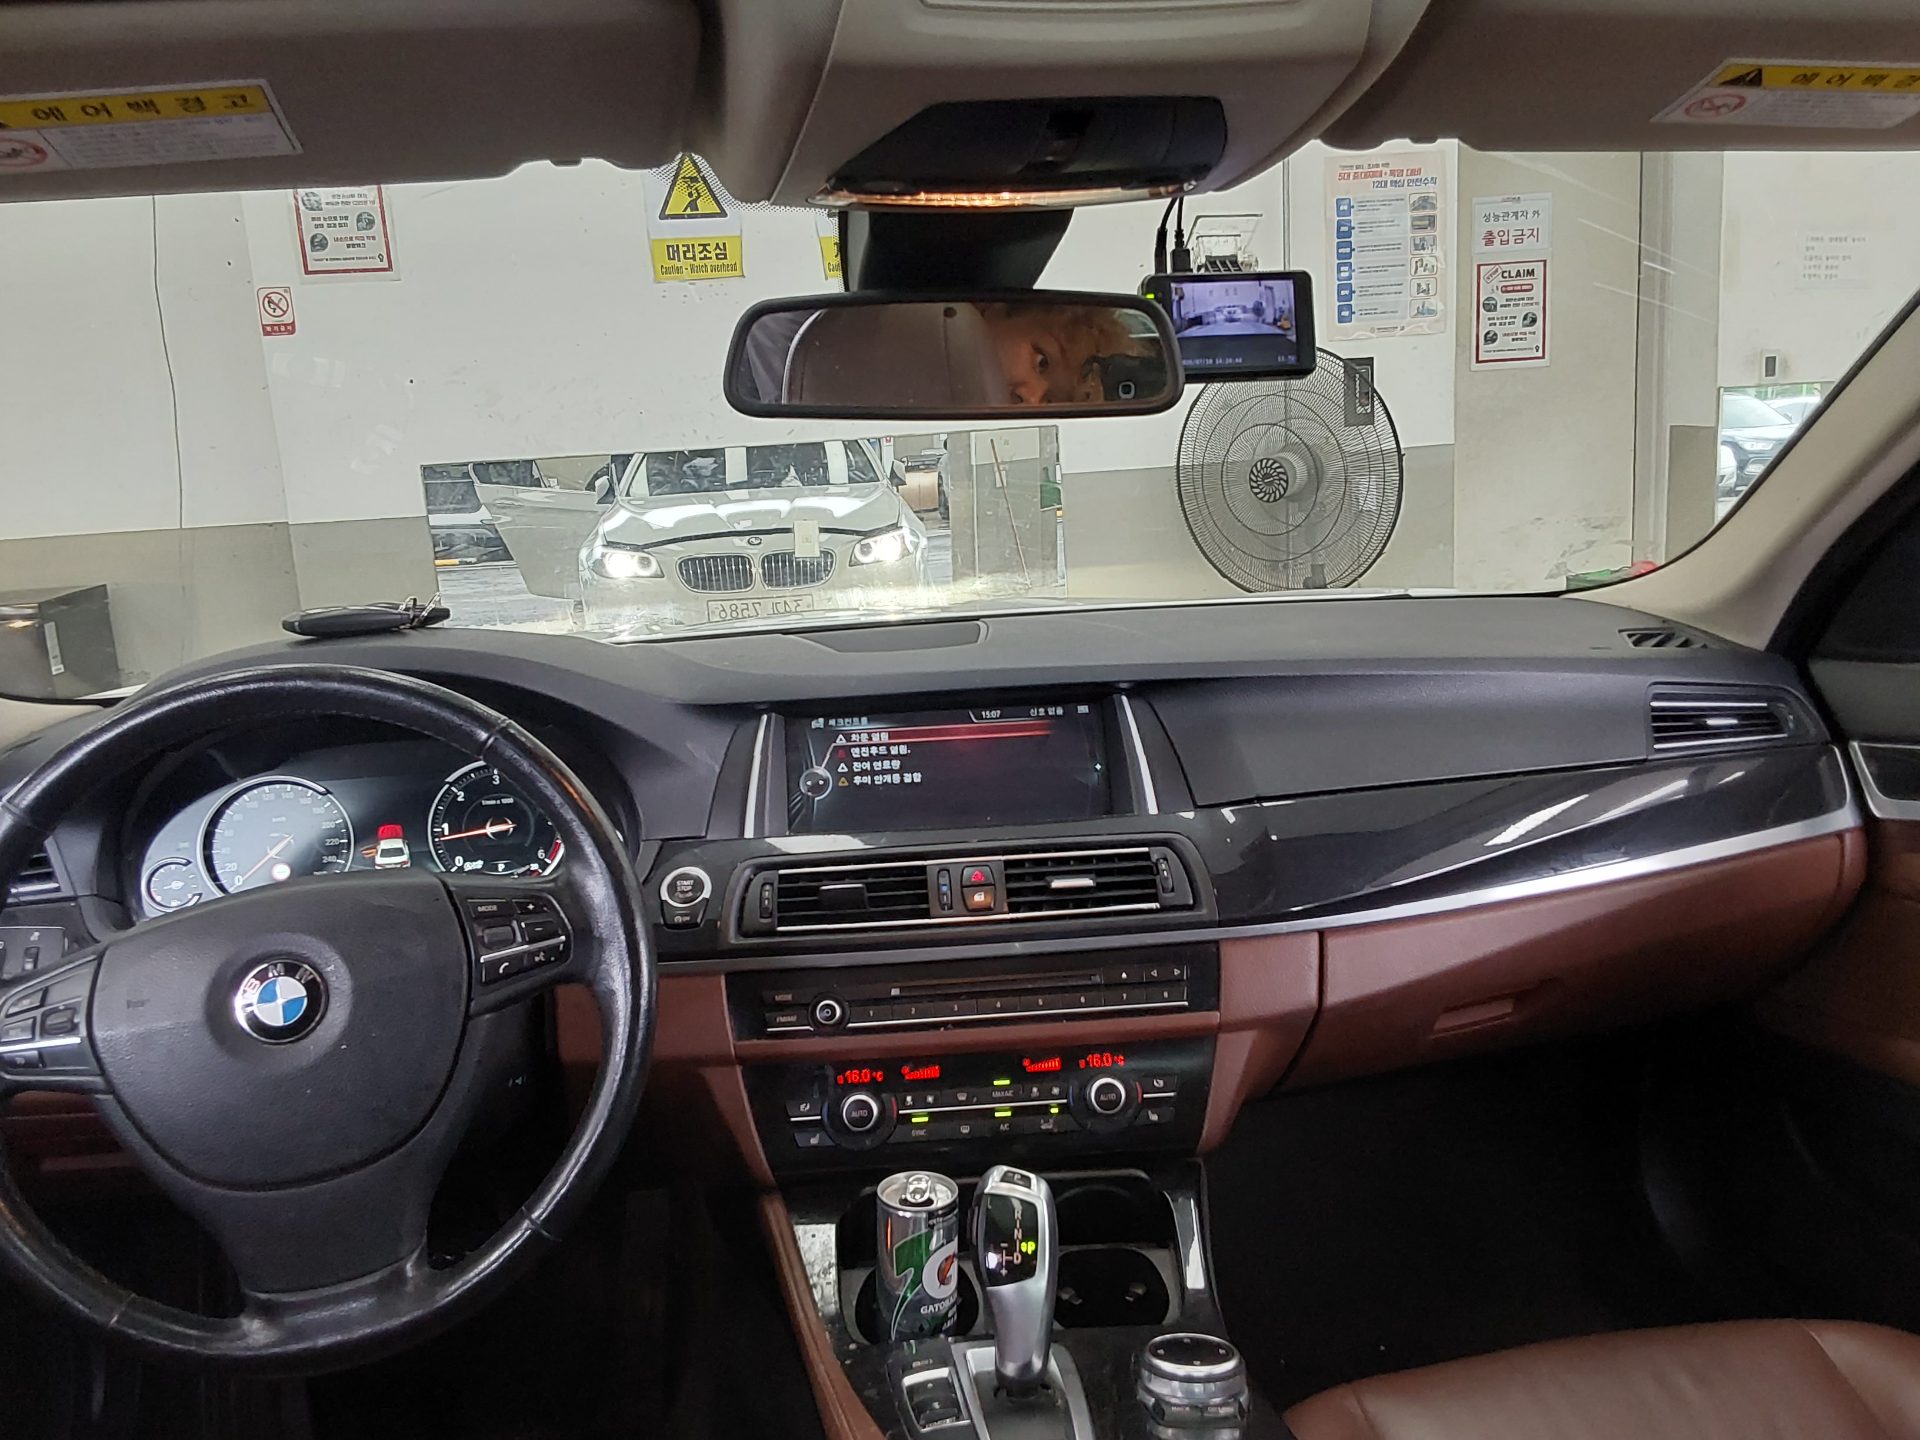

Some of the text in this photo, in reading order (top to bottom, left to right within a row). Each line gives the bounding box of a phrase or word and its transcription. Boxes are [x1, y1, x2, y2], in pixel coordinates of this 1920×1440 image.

[1372, 180, 1388, 189] 12대
[1406, 177, 1438, 187] 안전수칙
[1482, 210, 1529, 223] 성능관계자
[1481, 227, 1540, 247] 출입금지
[666, 242, 728, 262] 머리조심
[660, 264, 684, 276] Caution
[689, 263, 709, 274] Watch
[709, 261, 738, 273] overhead
[1501, 268, 1535, 279] CLAIM
[981, 710, 1001, 719] 15:07
[850, 733, 869, 742] 차문
[850, 746, 888, 758] 엔진후드
[852, 760, 901, 772] 잔여 연료량
[492, 775, 500, 785] 3
[457, 791, 465, 802] 2
[321, 821, 336, 829] 200
[441, 822, 449, 835] 1
[325, 838, 339, 846] 220
[537, 849, 545, 859] 6
[224, 862, 238, 871] 20
[454, 856, 464, 867] 0
[497, 863, 505, 872] P
[234, 875, 243, 885] 0
[869, 1009, 873, 1017] 1
[851, 1109, 868, 1118] AUTO
[1014, 1208, 1022, 1220] R
[1014, 1228, 1022, 1240] N
[1013, 1252, 1021, 1264] D
